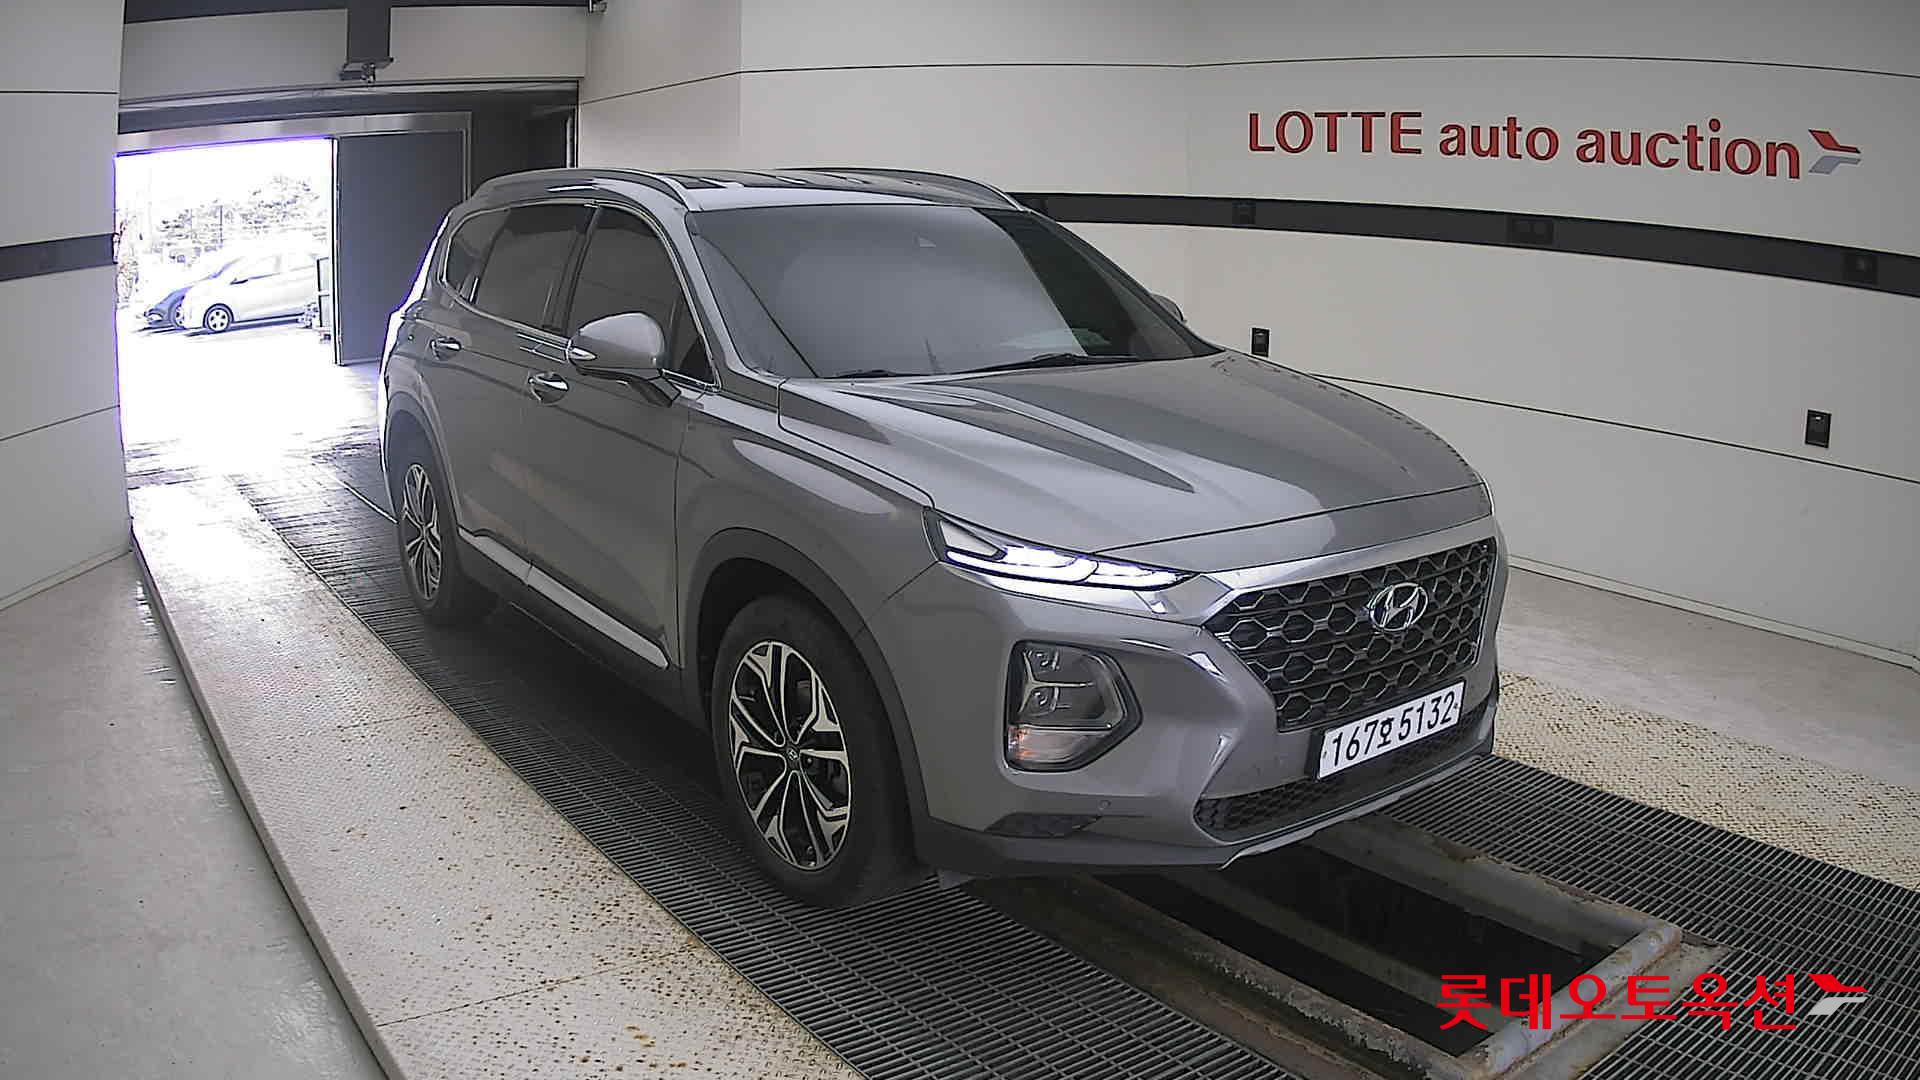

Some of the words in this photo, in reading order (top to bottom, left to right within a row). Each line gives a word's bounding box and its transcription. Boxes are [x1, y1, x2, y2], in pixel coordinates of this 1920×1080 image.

[1248, 111, 1423, 154] LOTTE
[1439, 116, 1560, 160] auto
[1576, 118, 1801, 179] auction
